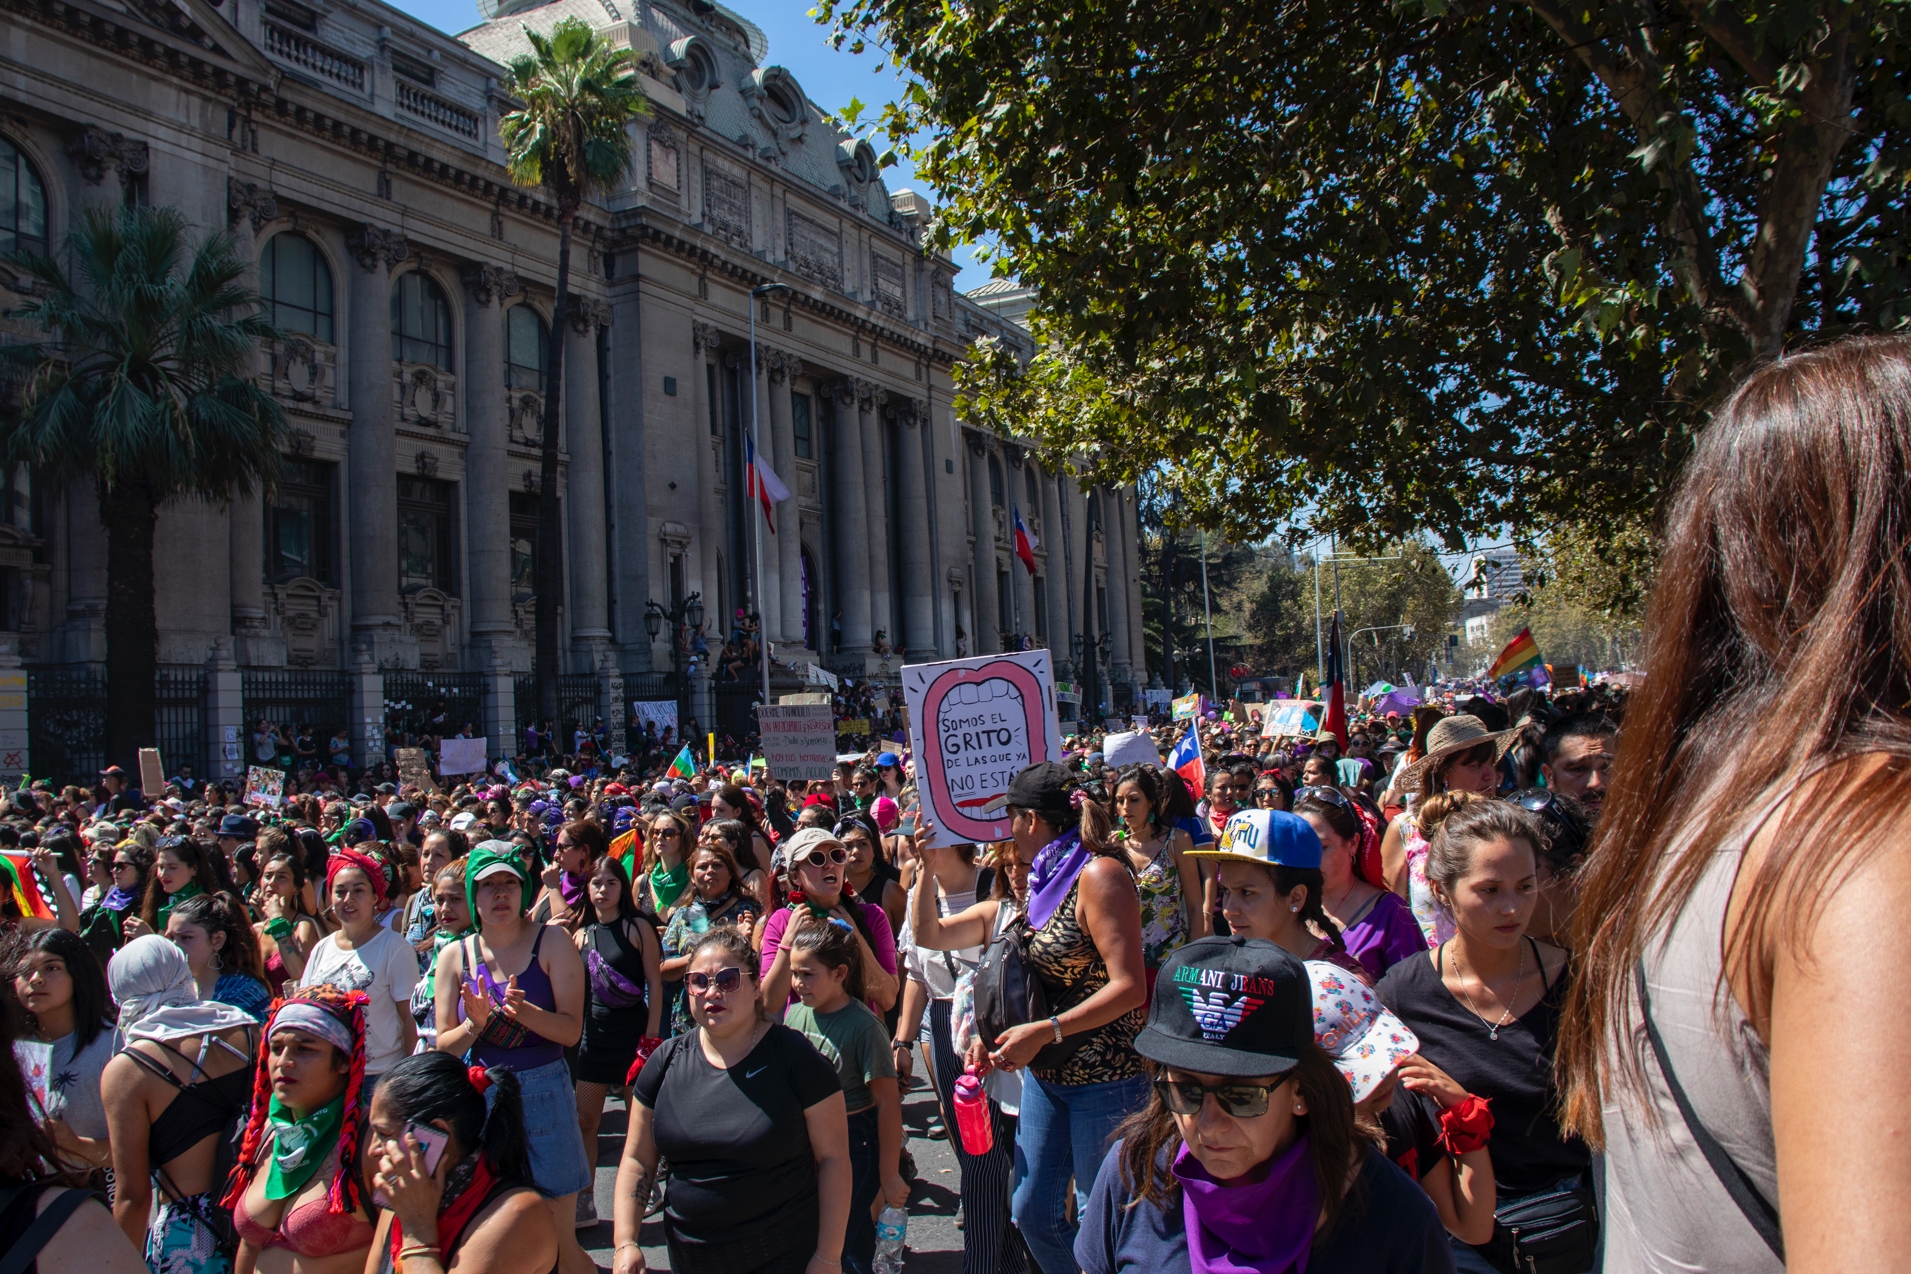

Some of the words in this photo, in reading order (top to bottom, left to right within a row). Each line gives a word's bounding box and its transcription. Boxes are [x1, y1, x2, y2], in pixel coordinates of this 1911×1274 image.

[757, 707, 781, 718] DUERME
[760, 721, 772, 734] SIN
[807, 720, 834, 734] AGRESOR
[942, 714, 986, 733] SOMOS
[991, 713, 1007, 724] EL
[944, 727, 1012, 755] GRITO
[771, 752, 784, 762] hoy
[786, 753, 797, 762] tus
[946, 758, 961, 769] DE
[966, 755, 987, 767] LAS
[989, 753, 1012, 763] QUE
[1016, 752, 1027, 761] YA
[772, 766, 802, 778] TOMAMOS
[950, 774, 975, 792] NO
[980, 766, 1020, 789] ESTÁ
[1173, 965, 1225, 988] ARMANI
[1231, 973, 1275, 996] JEANS
[1203, 1032, 1225, 1040] ITALY
[1322, 1008, 1367, 1047] CHILL
